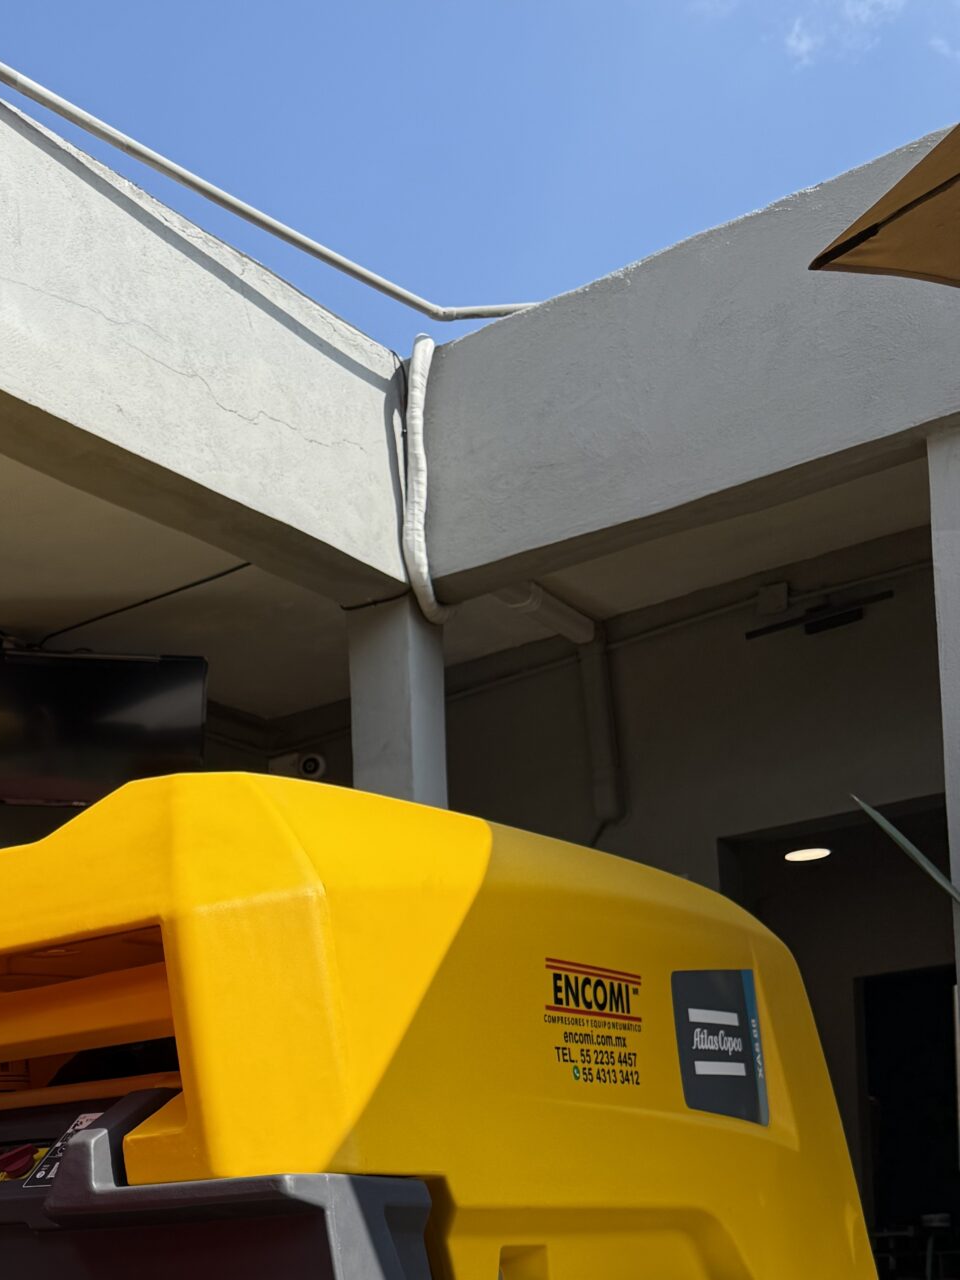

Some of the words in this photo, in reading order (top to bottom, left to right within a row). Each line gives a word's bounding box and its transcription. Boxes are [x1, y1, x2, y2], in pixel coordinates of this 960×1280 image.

[553, 973, 631, 1014] ENCOMI
[544, 1014, 585, 1027] COMPRESORES
[563, 1030, 627, 1048] encomi.com.mx
[555, 1046, 578, 1063] TEL.
[580, 1049, 592, 1064] 55
[593, 1050, 616, 1066] 2235
[617, 1051, 637, 1067] 4457
[582, 1067, 594, 1083] 55
[596, 1068, 618, 1084] 4313
[619, 1069, 641, 1086] 3412
